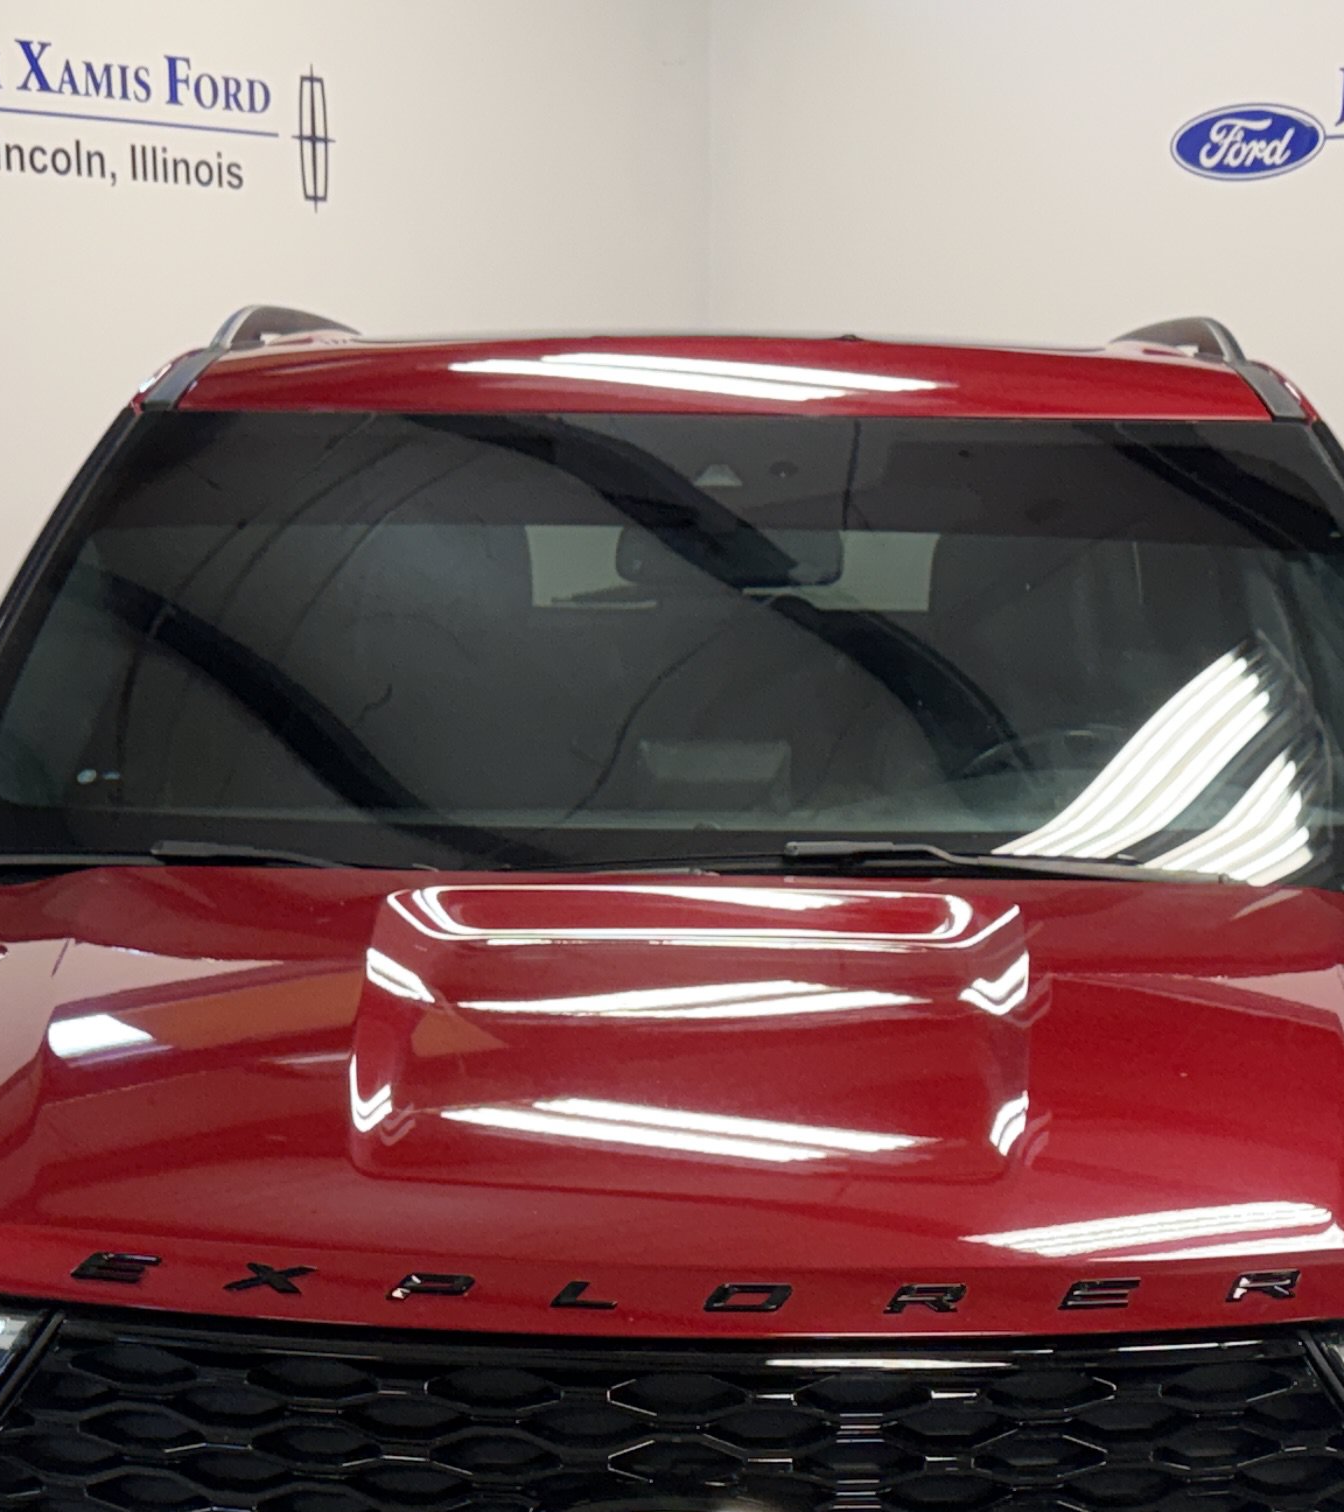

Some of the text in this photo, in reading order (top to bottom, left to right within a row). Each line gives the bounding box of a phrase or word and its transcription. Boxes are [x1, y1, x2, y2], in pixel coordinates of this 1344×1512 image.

[14, 39, 152, 104] XAMIS
[164, 55, 272, 114] FORD
[130, 142, 244, 190] Illinois
[1198, 117, 1291, 169] Ford
[70, 1251, 1302, 1316] EXPLORER
